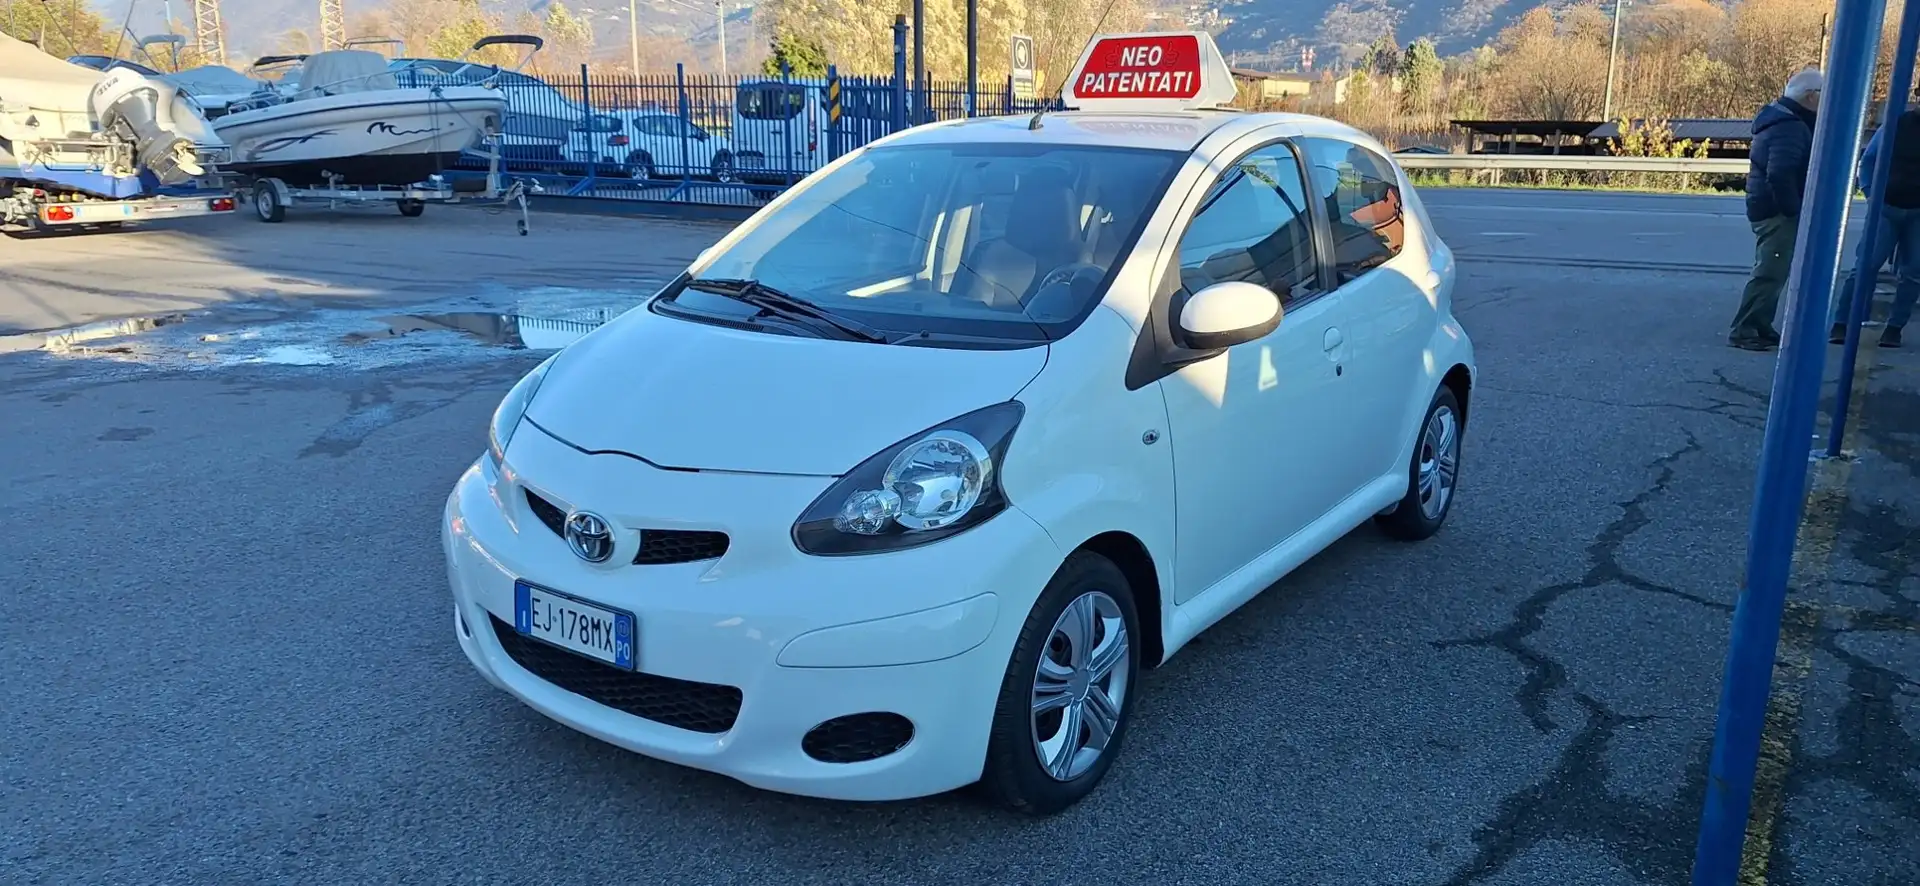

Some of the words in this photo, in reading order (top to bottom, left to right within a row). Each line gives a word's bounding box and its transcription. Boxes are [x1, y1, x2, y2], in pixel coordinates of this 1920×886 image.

[1121, 46, 1162, 67] NEO
[1081, 71, 1193, 93] PATENTATI
[616, 640, 631, 661] PO
